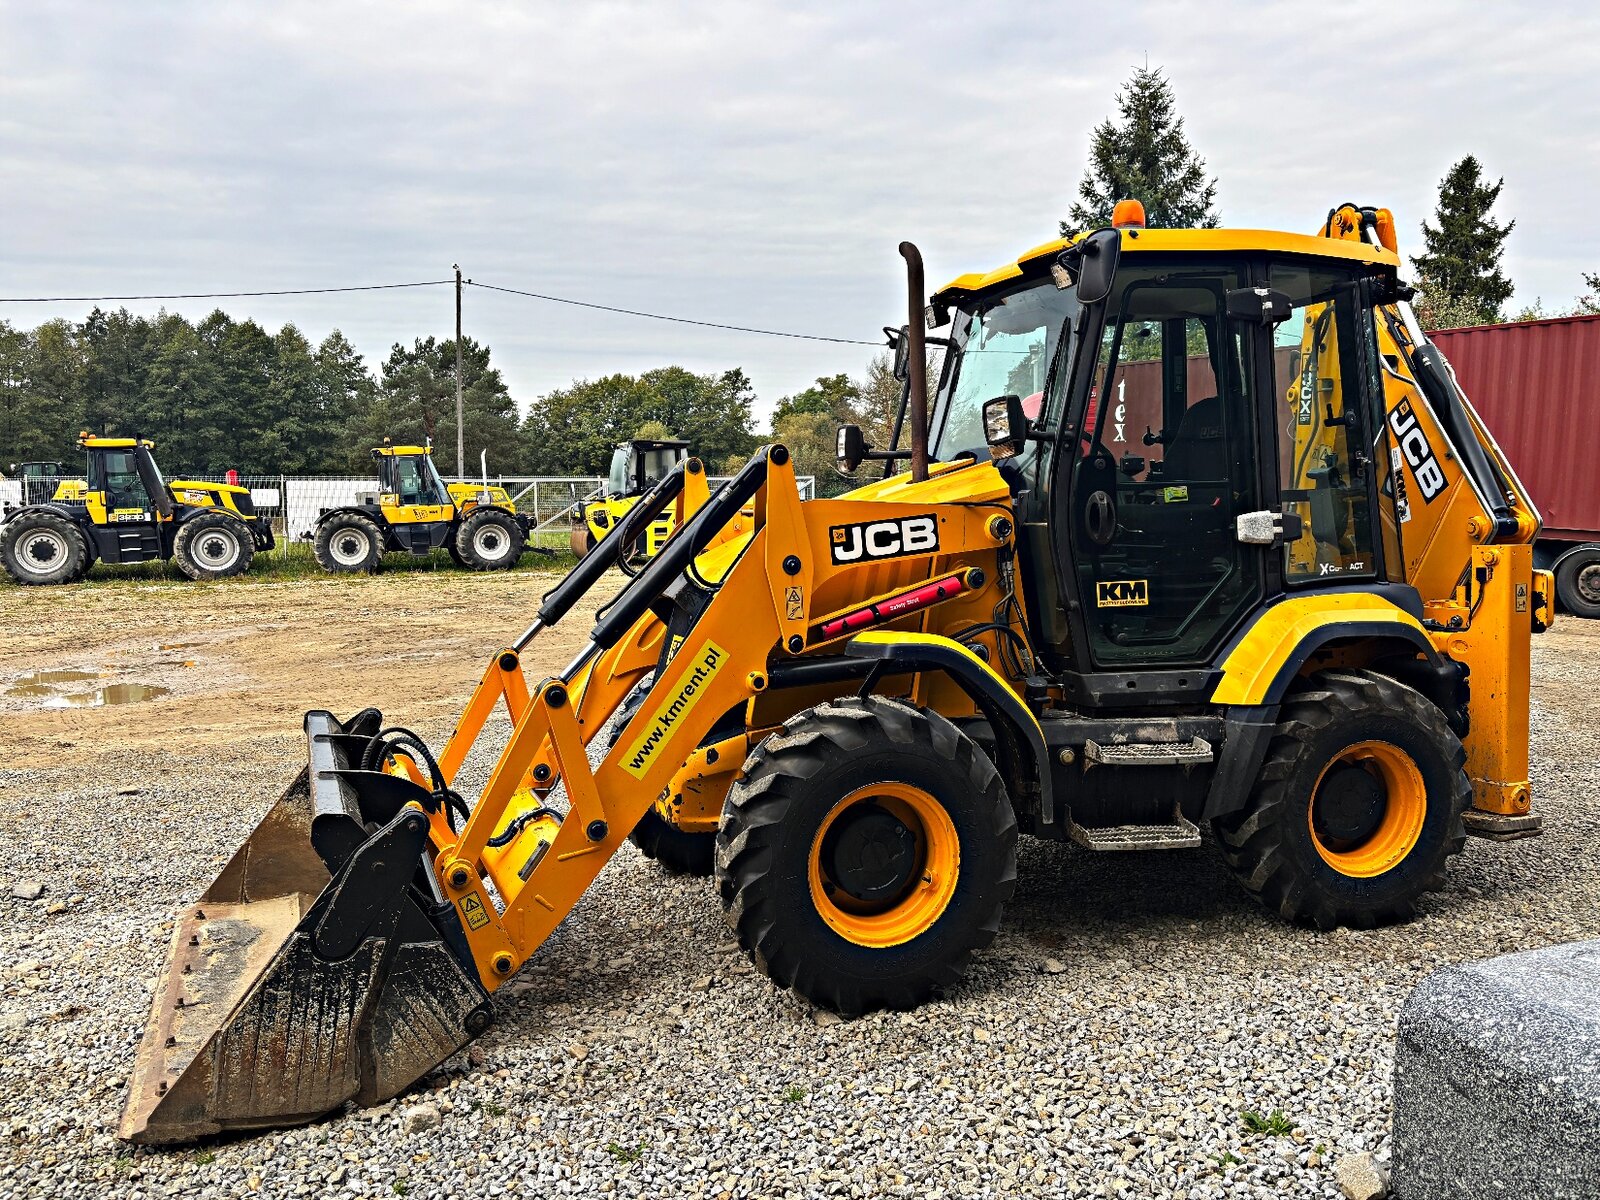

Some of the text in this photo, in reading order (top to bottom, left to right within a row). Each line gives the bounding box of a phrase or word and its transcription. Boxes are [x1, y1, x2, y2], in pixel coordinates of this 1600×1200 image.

[1113, 378, 1127, 443] tex
[1390, 410, 1444, 499] JCB
[834, 517, 938, 561] JCB
[1099, 582, 1146, 601] KM
[629, 646, 723, 770] www.kmrent.pl
